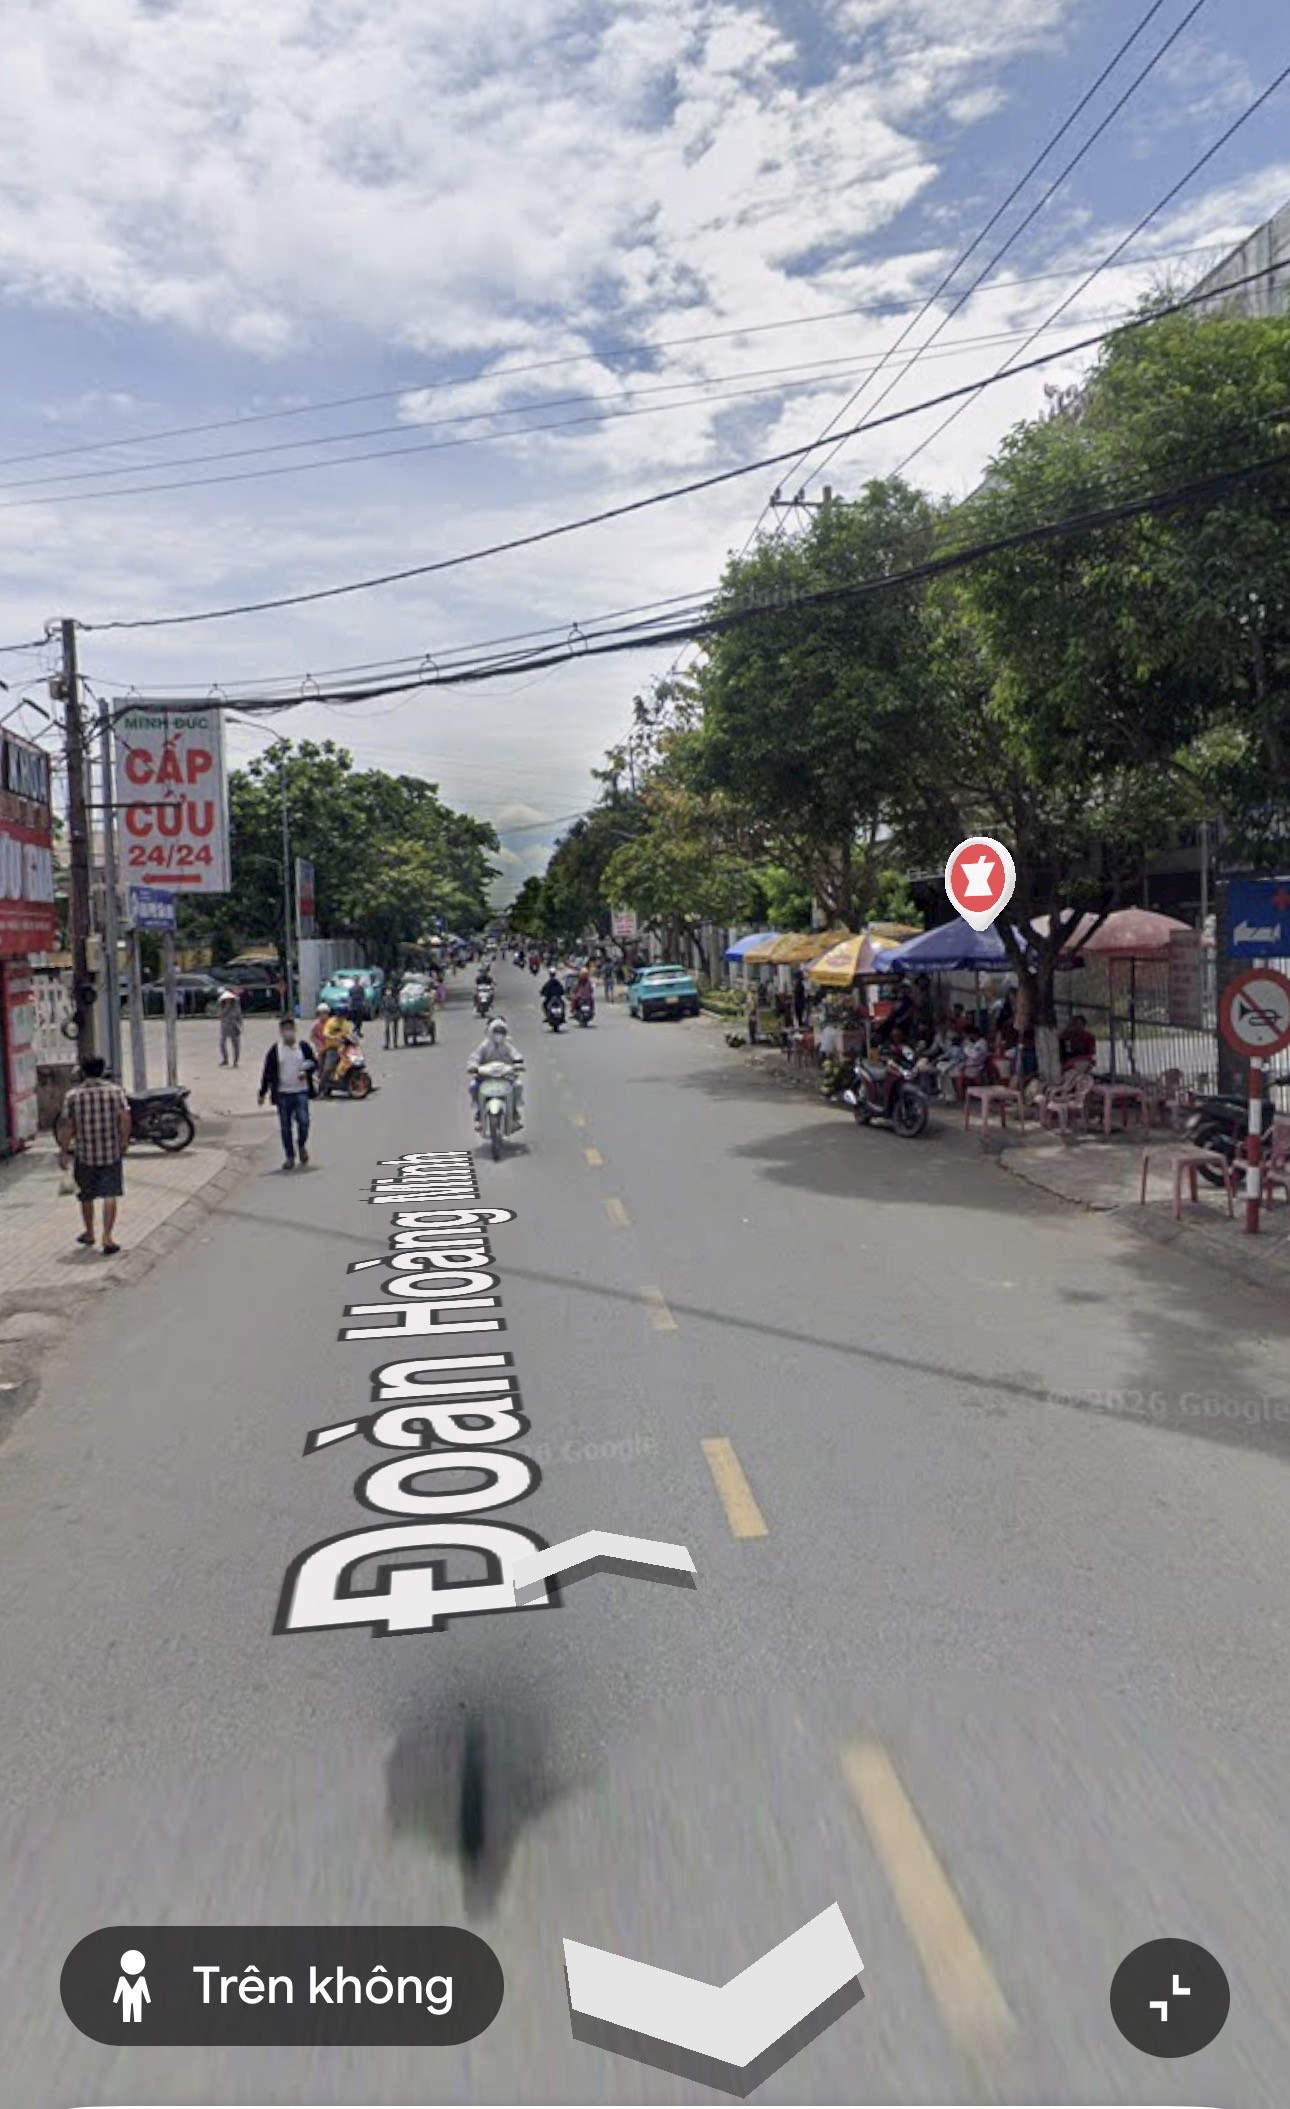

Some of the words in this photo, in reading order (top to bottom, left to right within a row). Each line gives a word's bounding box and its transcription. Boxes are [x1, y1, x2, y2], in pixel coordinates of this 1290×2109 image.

[126, 732, 213, 785] CẤP
[126, 789, 215, 837] CỨU
[128, 843, 214, 868] 24/24
